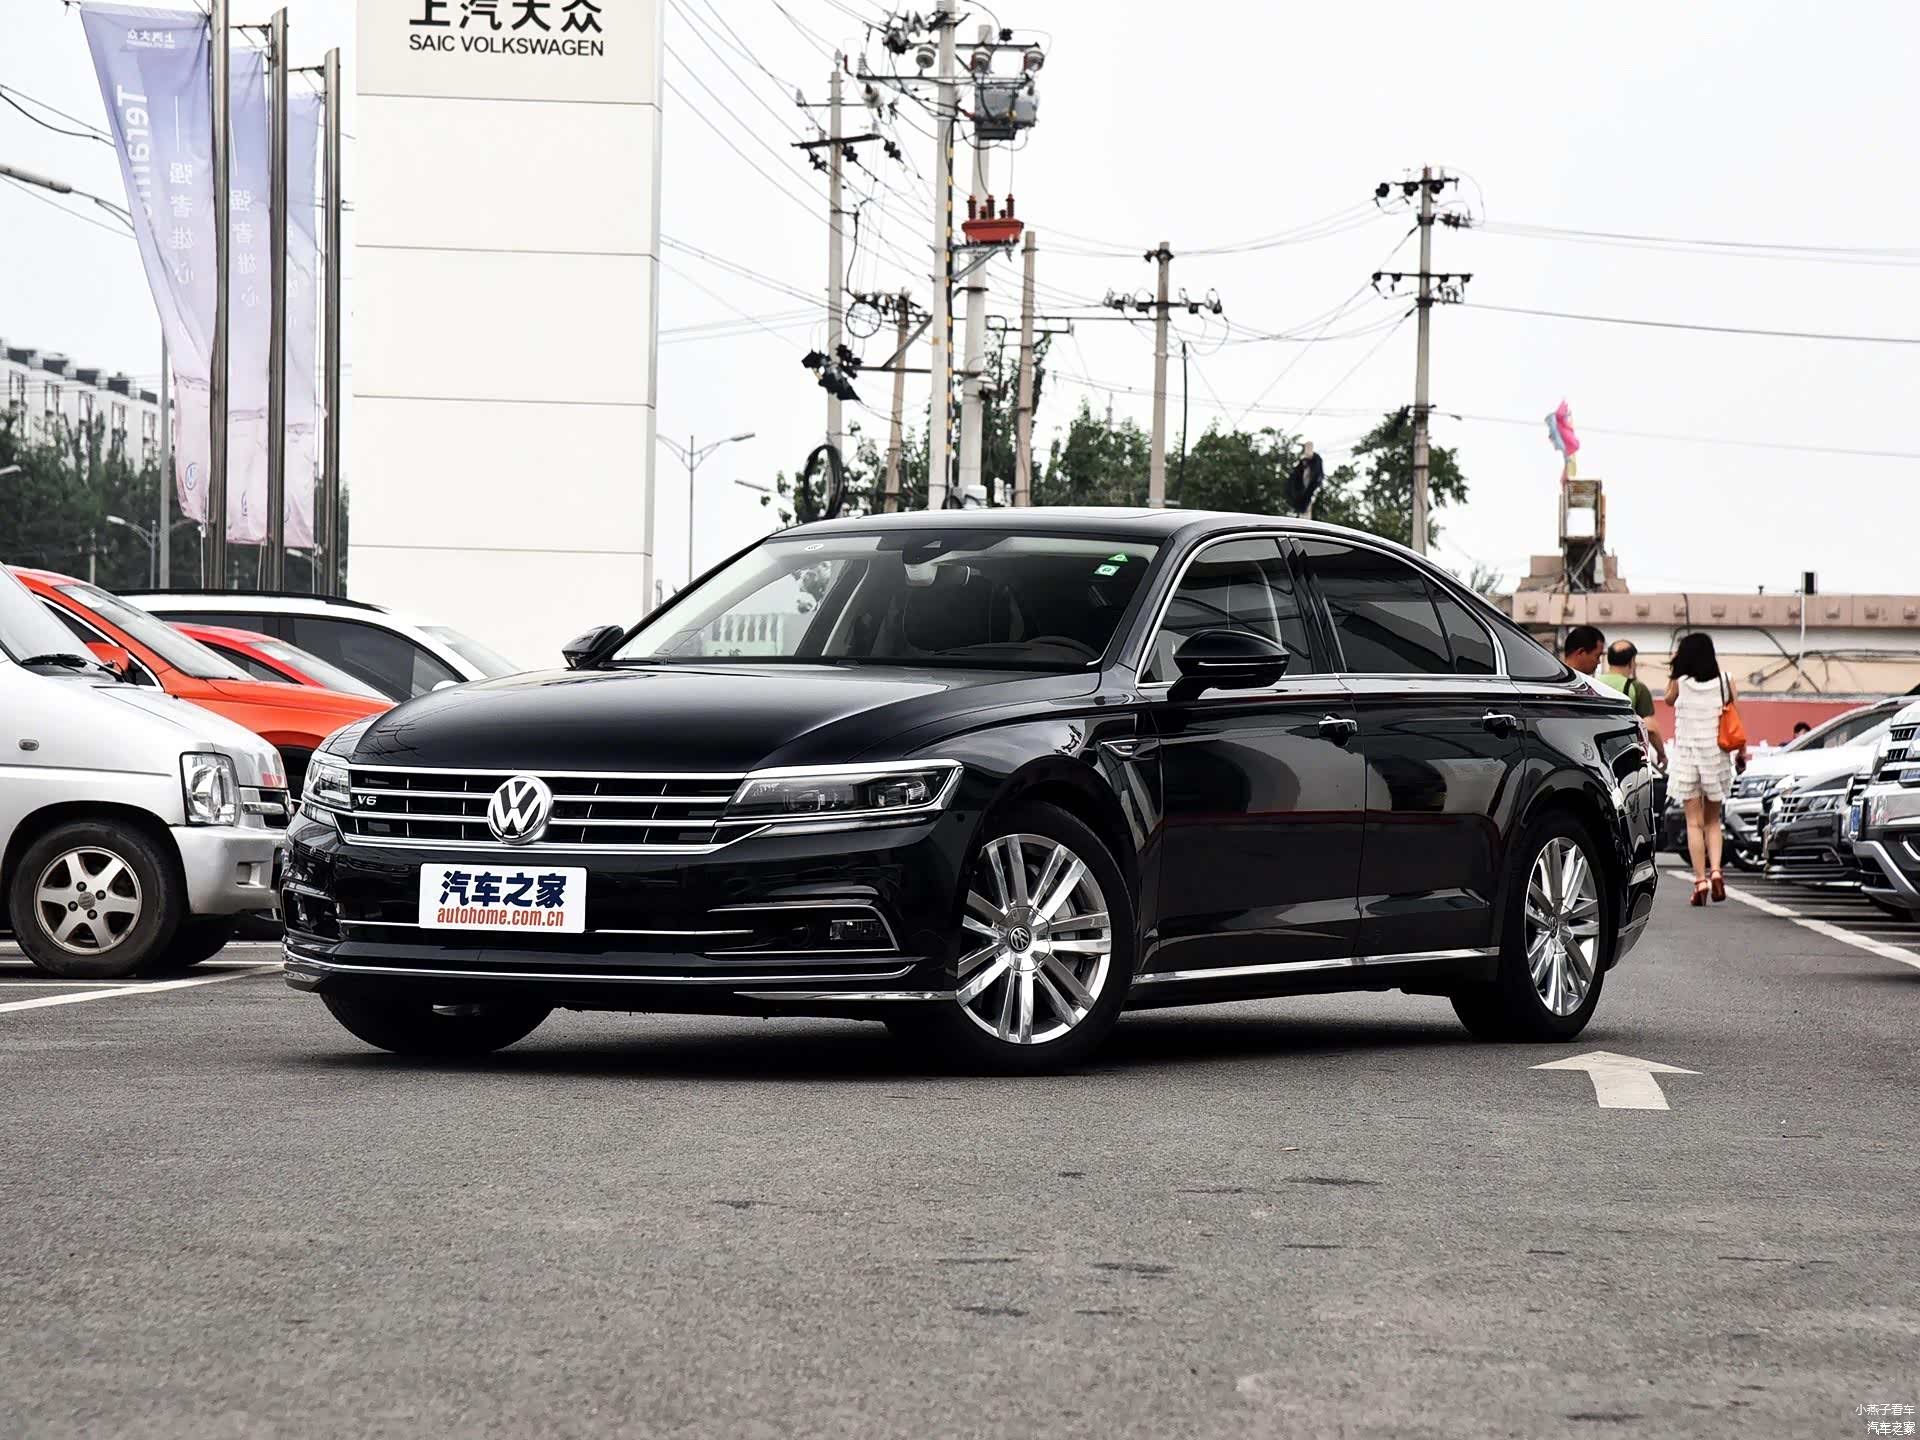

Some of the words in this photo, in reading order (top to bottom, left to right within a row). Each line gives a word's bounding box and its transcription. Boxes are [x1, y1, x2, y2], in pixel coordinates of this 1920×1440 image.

[409, 0, 603, 33] 上汽大众
[409, 34, 455, 52] SAIC
[461, 36, 604, 57] VOLKSWAGEN
[356, 794, 377, 807] V6
[438, 870, 567, 909] 汽车之家
[436, 905, 565, 928] autohome.com.cn
